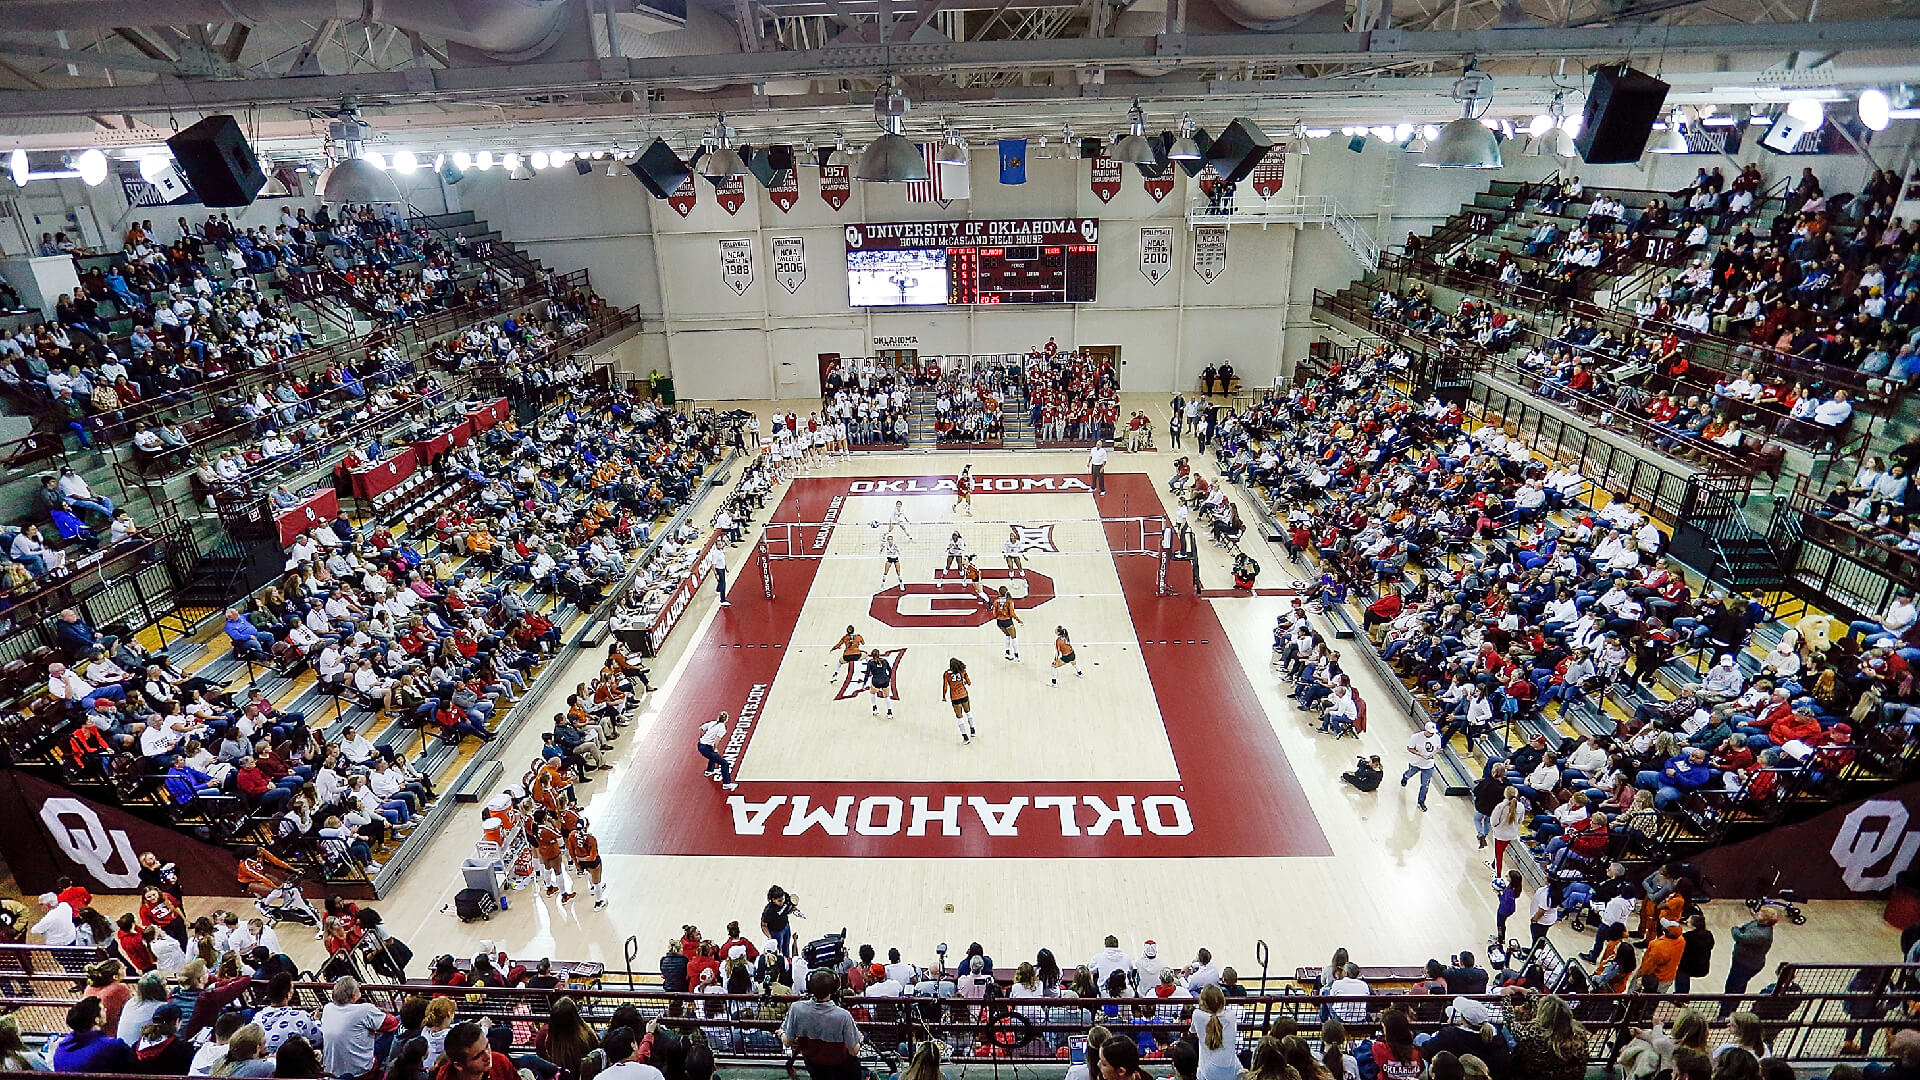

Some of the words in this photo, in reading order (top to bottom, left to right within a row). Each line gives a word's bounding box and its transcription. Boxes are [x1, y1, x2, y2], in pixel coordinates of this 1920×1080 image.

[824, 167, 844, 177] 1957
[1095, 159, 1118, 168] 1960
[845, 225, 863, 248] OU
[866, 222, 960, 239] UNIVERSITY
[965, 222, 984, 235] OF
[989, 220, 1077, 235] OKLAHOMA
[1081, 219, 1098, 243] OU
[900, 237, 936, 247] HOWARD
[989, 235, 1013, 245] FIELD
[1016, 234, 1043, 244] HOUSE
[1144, 253, 1168, 264] 2010
[726, 264, 750, 275] 1988
[777, 262, 803, 273] 2006
[980, 296, 989, 304] 20
[990, 295, 1000, 304] 25
[873, 336, 918, 344] OKLAHOMA
[849, 477, 1092, 494] OKLAHOMA
[761, 556, 772, 599] SOONERS
[1159, 551, 1167, 594] SOONERS
[652, 583, 692, 653] OKLAHOMA
[951, 673, 962, 682] 33
[726, 795, 1196, 837] OKLAHOMA
[39, 797, 142, 889] OU
[1829, 799, 1920, 892] OU
